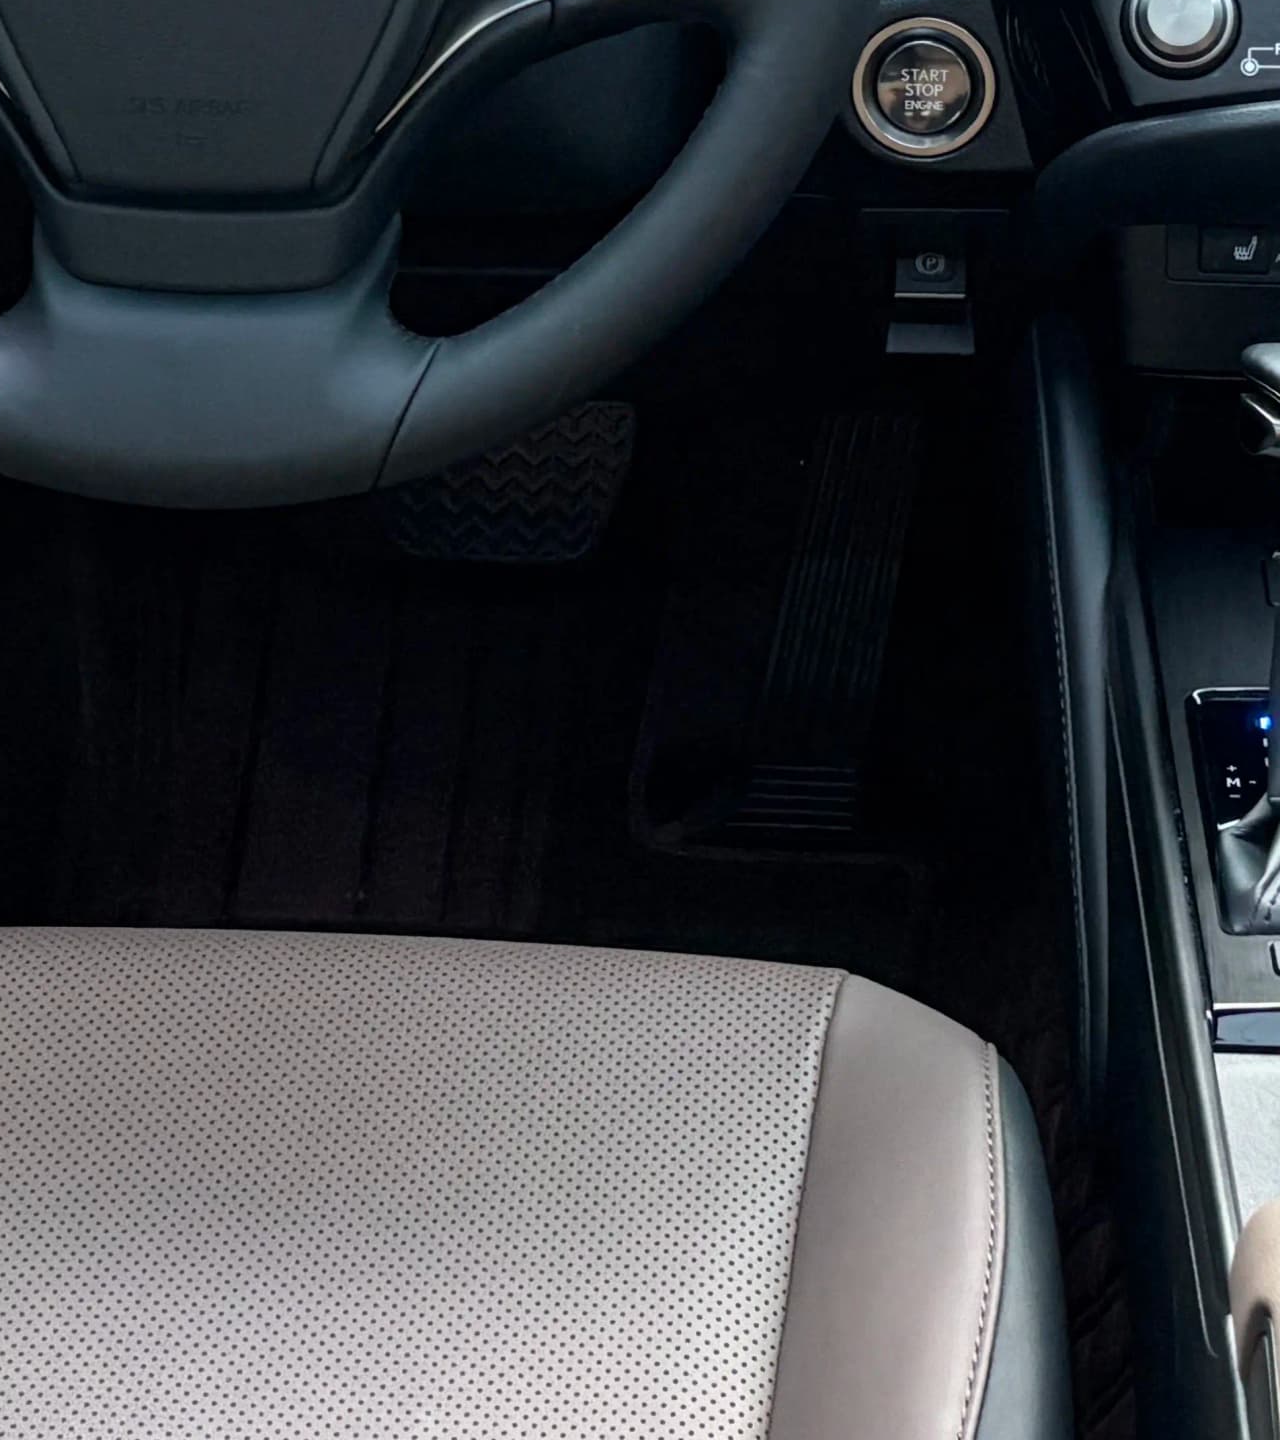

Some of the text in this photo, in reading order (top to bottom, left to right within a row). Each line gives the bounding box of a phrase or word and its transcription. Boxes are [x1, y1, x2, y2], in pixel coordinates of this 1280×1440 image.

[901, 68, 950, 82] START
[904, 83, 944, 97] STOP
[904, 100, 945, 111] ENGINE
